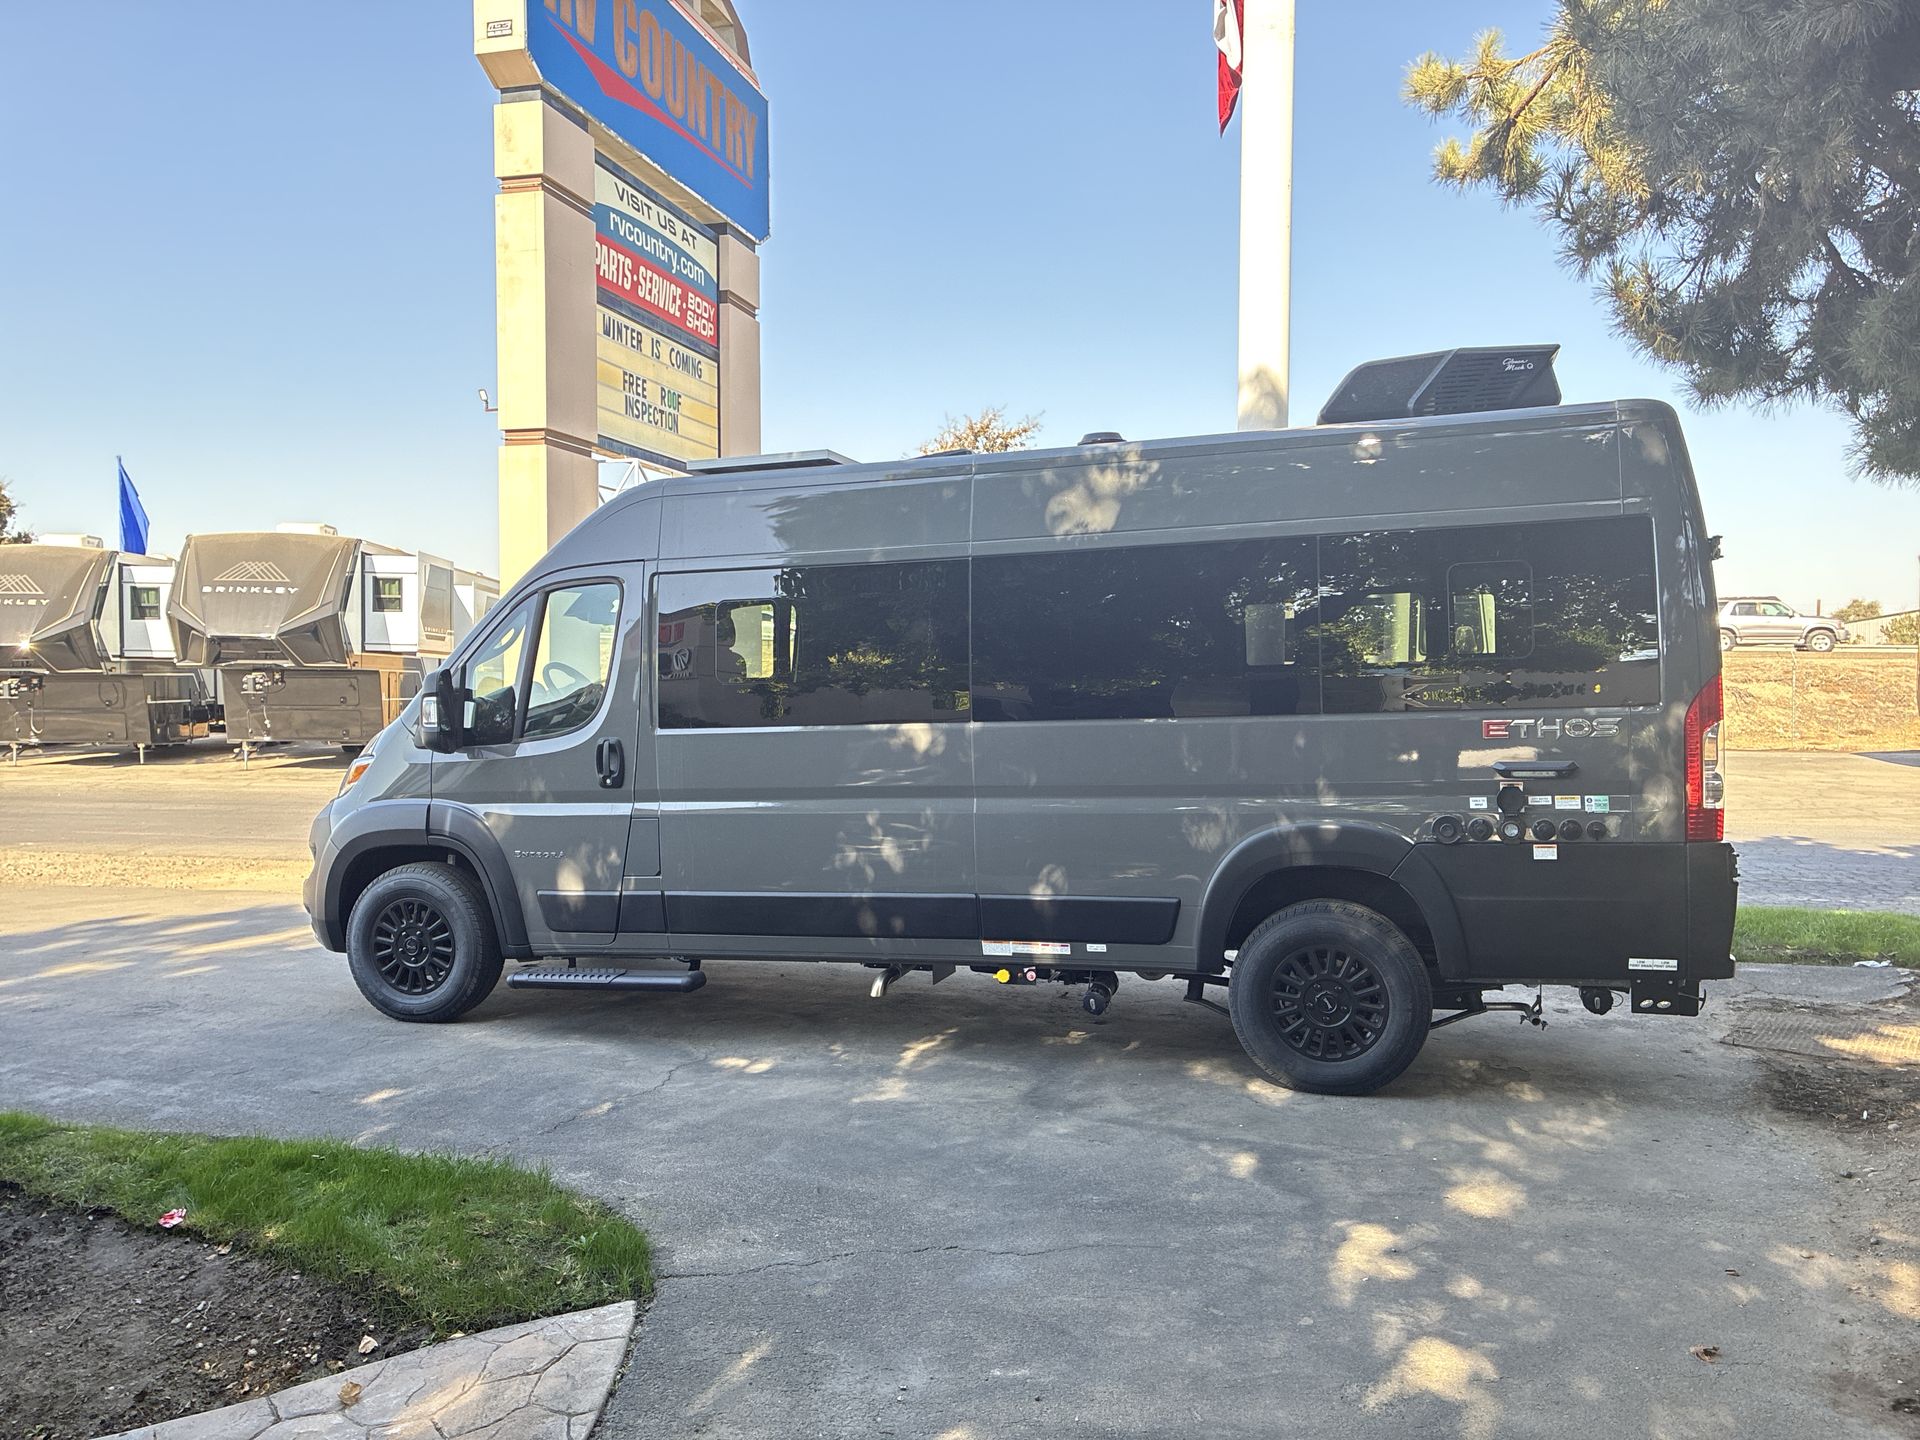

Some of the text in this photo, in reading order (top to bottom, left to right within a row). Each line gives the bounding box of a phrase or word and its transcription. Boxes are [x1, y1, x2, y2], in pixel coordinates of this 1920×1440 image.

[613, 0, 757, 181] COUNTRY
[614, 181, 698, 250] VISIT US AT
[609, 211, 705, 287] rvcountry.com
[638, 265, 682, 318] SERVICE
[687, 291, 715, 321] BODY
[602, 313, 703, 379] WINTER IS COMING
[686, 311, 714, 338] SHOP
[622, 370, 682, 413] FREE ROOF
[624, 395, 679, 434] INSPECTION
[0, 598, 50, 606] KLEY
[201, 585, 299, 594] BRINKLEY
[1482, 717, 1623, 740] ETHOS
